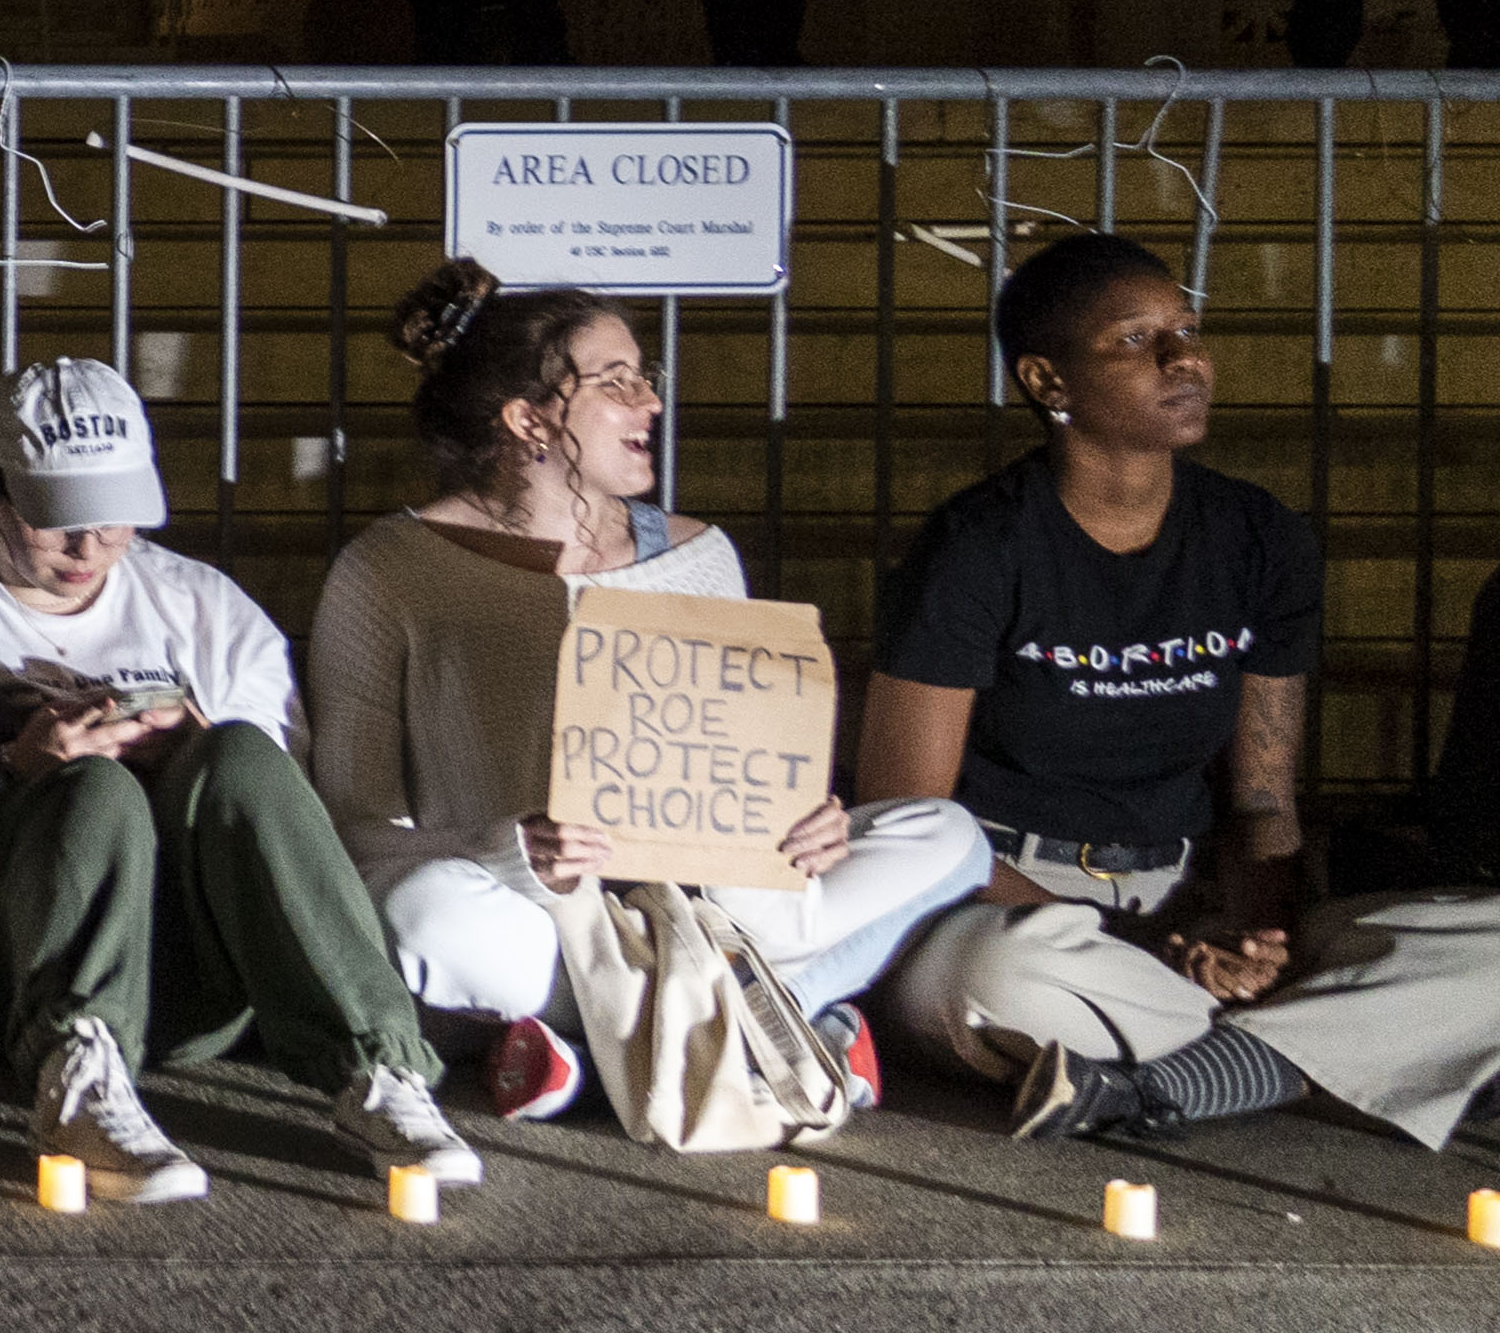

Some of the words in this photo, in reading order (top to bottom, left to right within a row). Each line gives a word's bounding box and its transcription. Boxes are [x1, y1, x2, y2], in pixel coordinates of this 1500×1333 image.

[493, 153, 595, 185] AREA
[611, 153, 750, 185] CLOSED
[486, 221, 504, 236] By
[509, 221, 545, 235] order
[550, 221, 565, 235] of
[571, 221, 592, 235] the
[597, 221, 653, 237] Supreme
[658, 221, 695, 235] Court
[701, 221, 754, 235] Marshal
[40, 415, 129, 448] BOSTON
[575, 627, 818, 696] PROTECT
[1070, 679, 1091, 699] IS
[1094, 670, 1223, 699] HEALTHCARE
[628, 692, 729, 738] ROE
[562, 725, 812, 790] PROTECT
[592, 783, 773, 834] CHOICE
